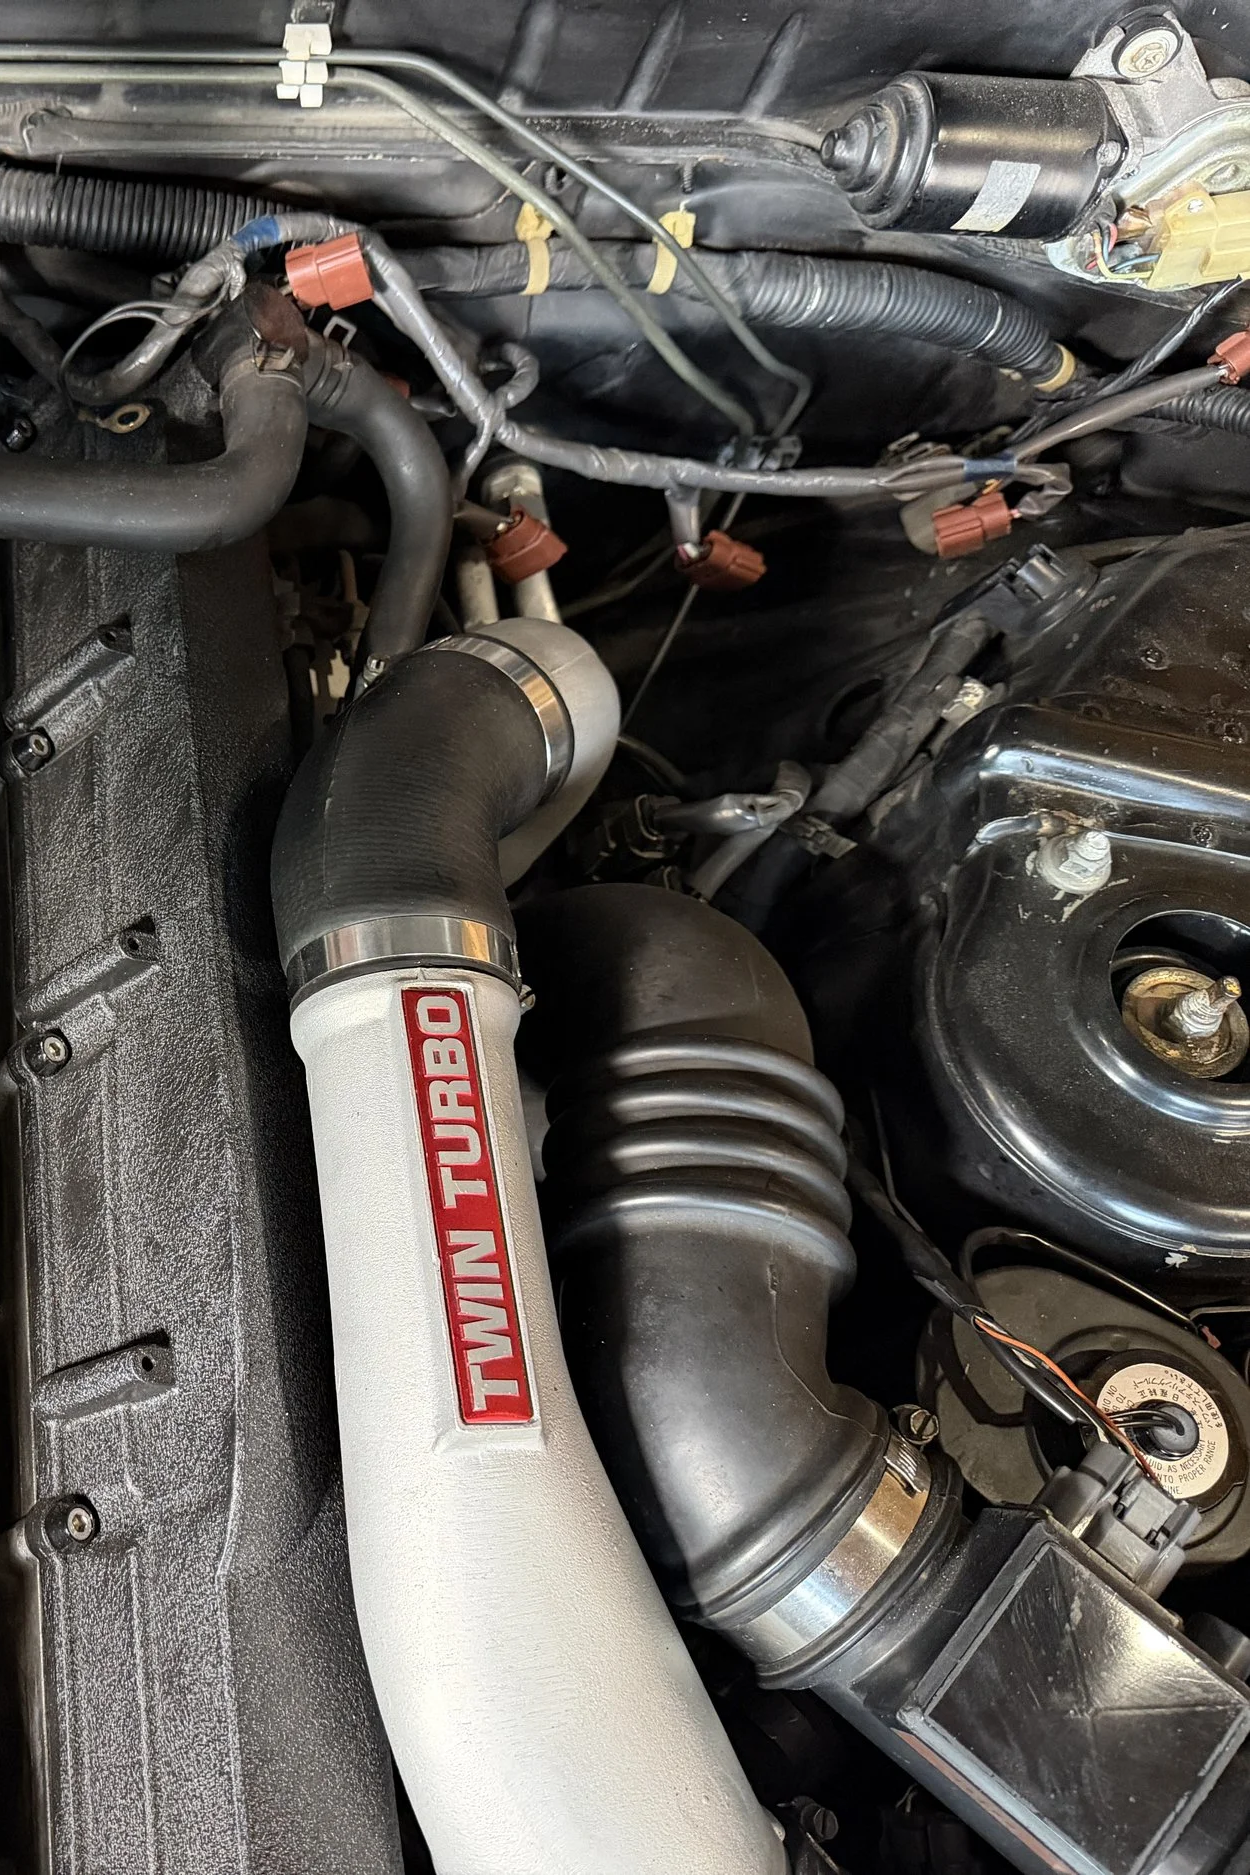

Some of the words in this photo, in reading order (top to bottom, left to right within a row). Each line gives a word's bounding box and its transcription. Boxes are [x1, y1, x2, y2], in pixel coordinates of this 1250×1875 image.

[416, 995, 488, 1209] TURBO
[448, 1230, 519, 1412] TWIN
[1178, 1464, 1207, 1483] PROPER
[1203, 1440, 1216, 1465] RANGE
